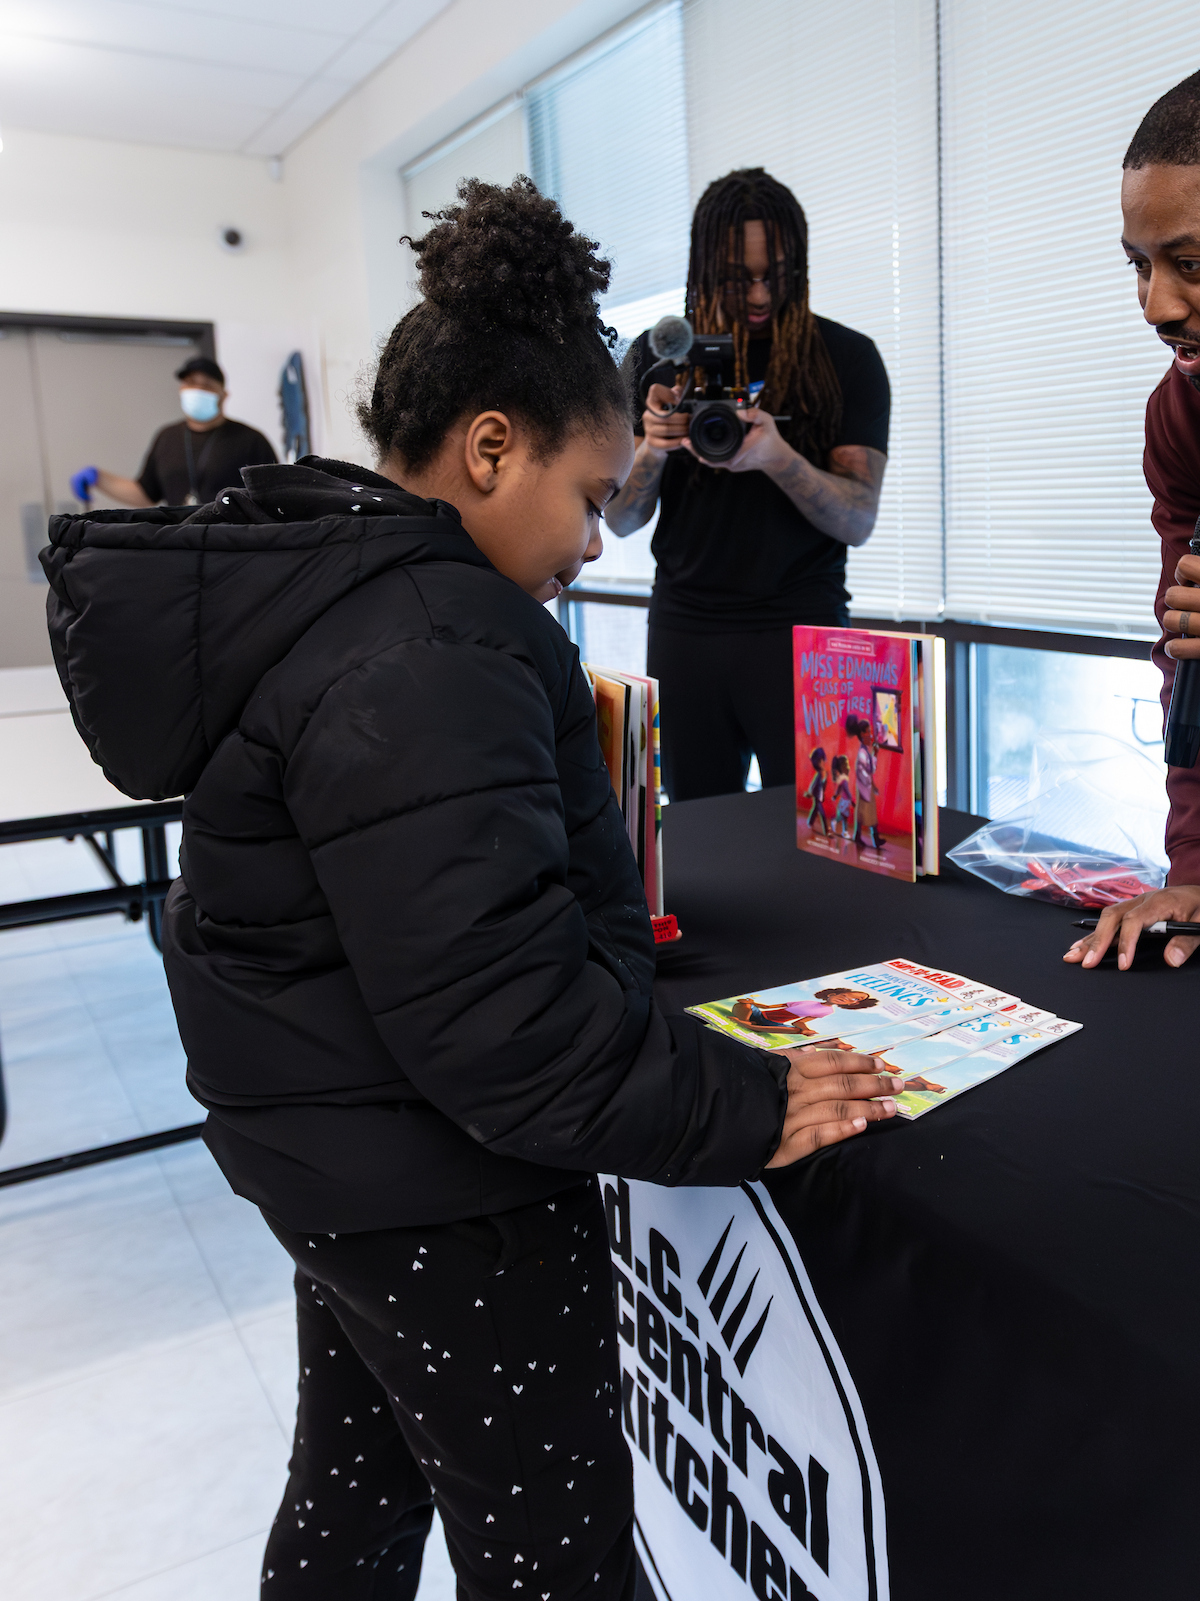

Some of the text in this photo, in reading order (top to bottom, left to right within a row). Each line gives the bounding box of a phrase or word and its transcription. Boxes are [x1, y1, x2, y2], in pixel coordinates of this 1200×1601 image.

[801, 651, 898, 686] MISS EDMONIA'S
[813, 680, 854, 697] CLASS OF
[802, 694, 871, 737] WILDFIRES
[844, 973, 935, 1007] FEELINGS
[613, 1263, 829, 1577] central
